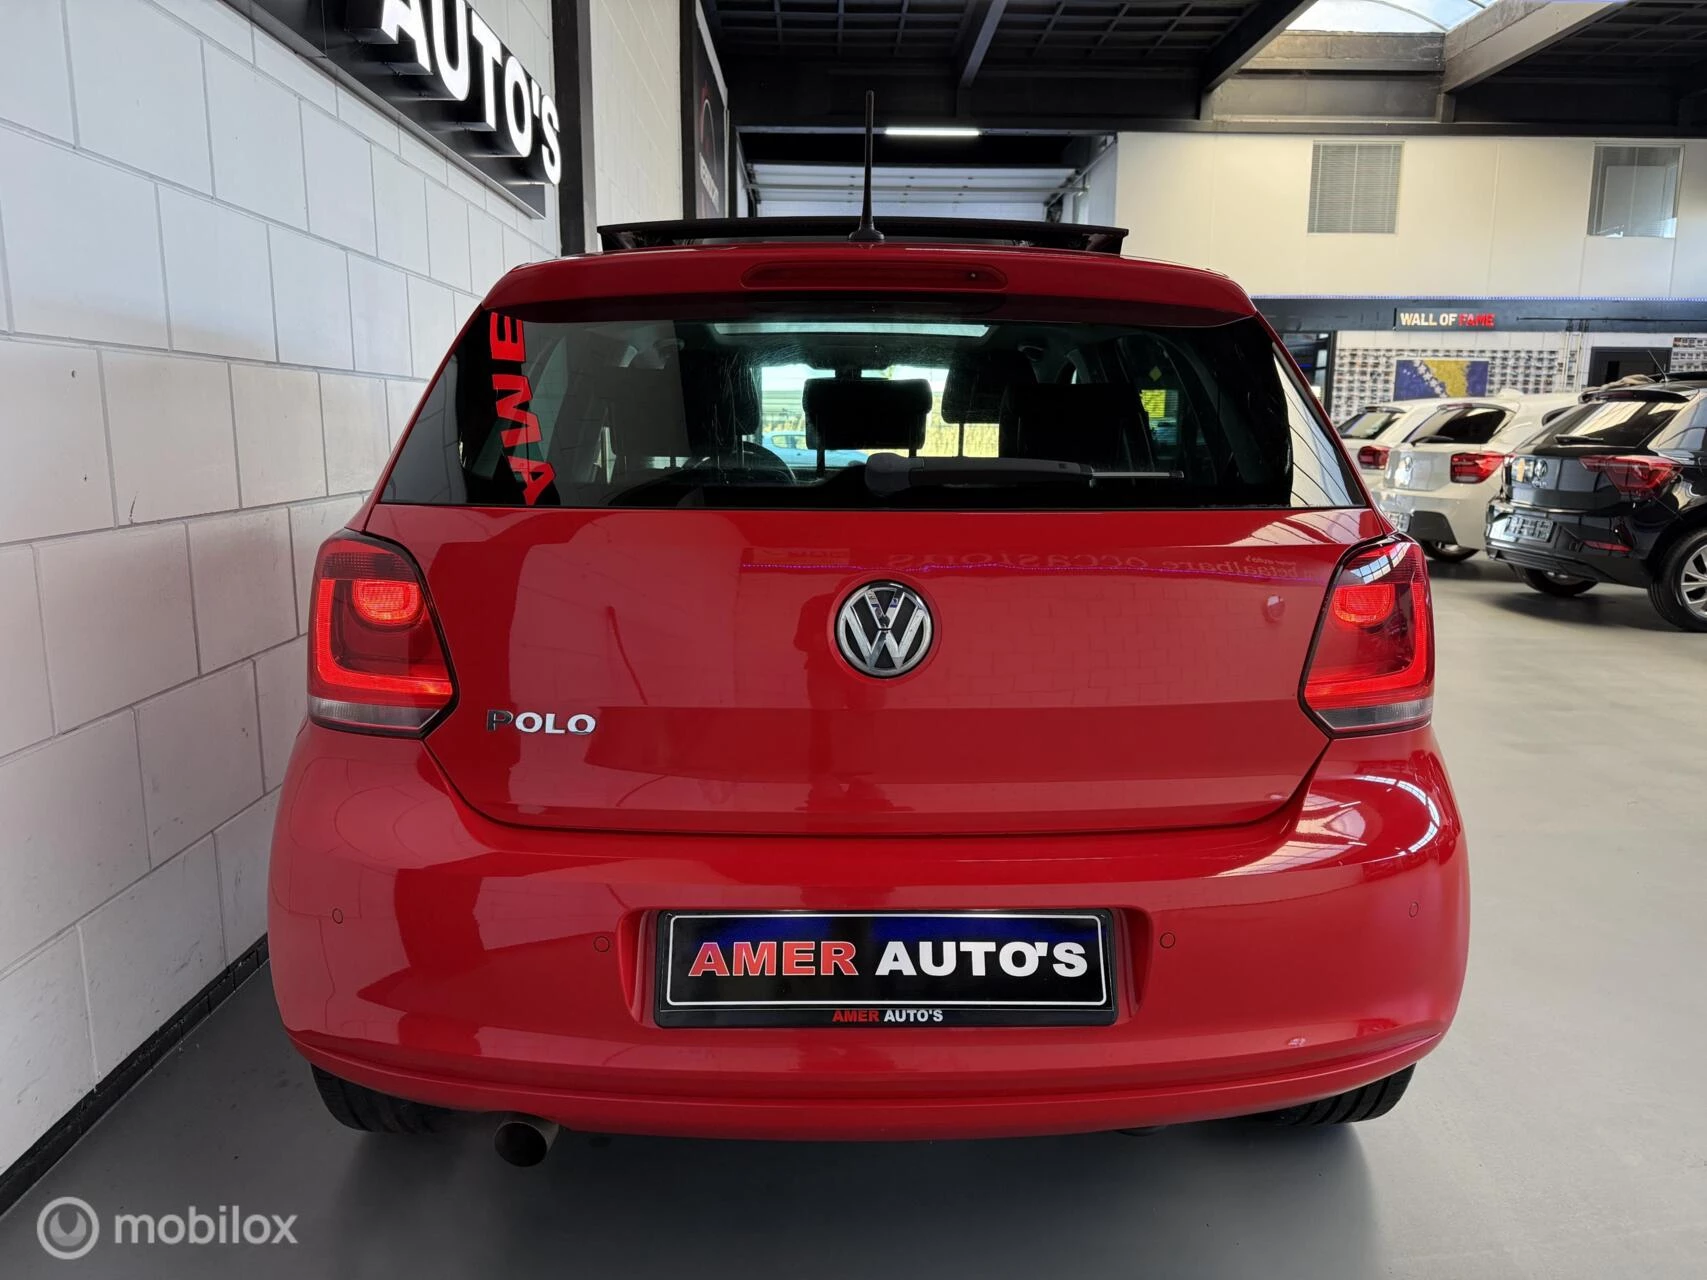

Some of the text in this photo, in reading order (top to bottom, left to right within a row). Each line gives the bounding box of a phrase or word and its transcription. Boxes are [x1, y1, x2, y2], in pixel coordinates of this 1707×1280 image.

[381, 0, 561, 185] AUTO'S
[1400, 313, 1495, 327] WALL OF FAME
[487, 710, 597, 734] POLO
[688, 941, 1088, 977] AMER AUTO'S
[832, 1010, 944, 1023] AMER AUTO'S
